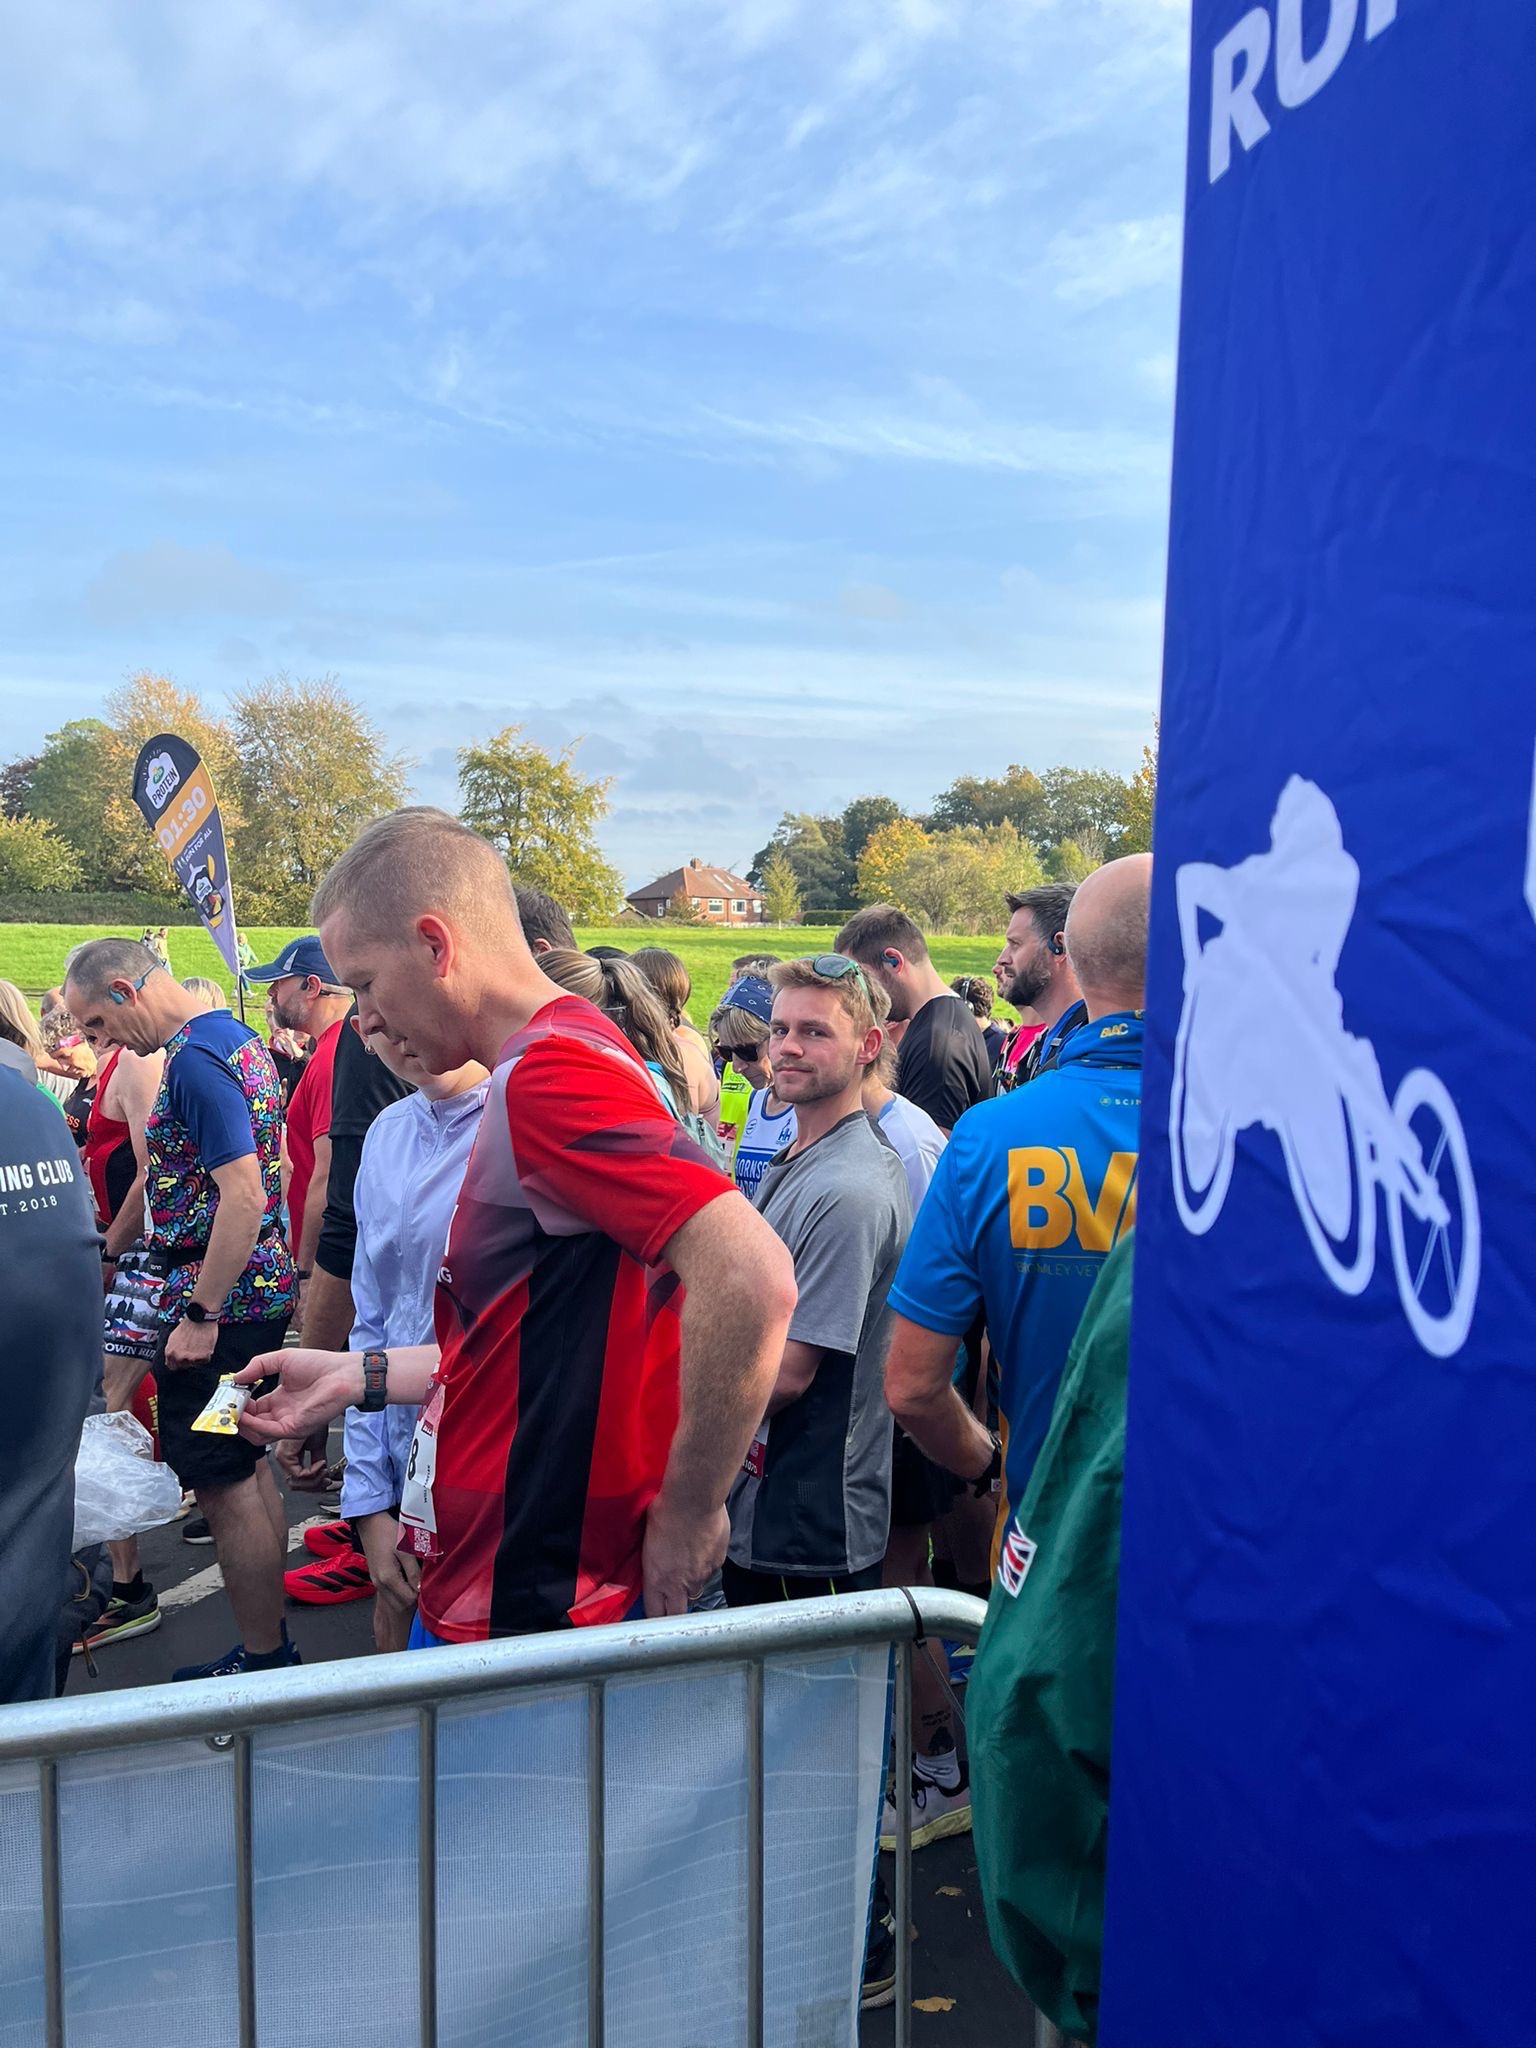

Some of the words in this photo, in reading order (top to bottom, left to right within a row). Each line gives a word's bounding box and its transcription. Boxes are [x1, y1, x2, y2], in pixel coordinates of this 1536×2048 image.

[1209, 0, 1398, 185] RU
[152, 767, 178, 805] PROTEIN
[159, 786, 207, 850] 01:30
[194, 837, 204, 851] FOR
[203, 827, 213, 840] ALL
[37, 1159, 74, 1186] CLUB
